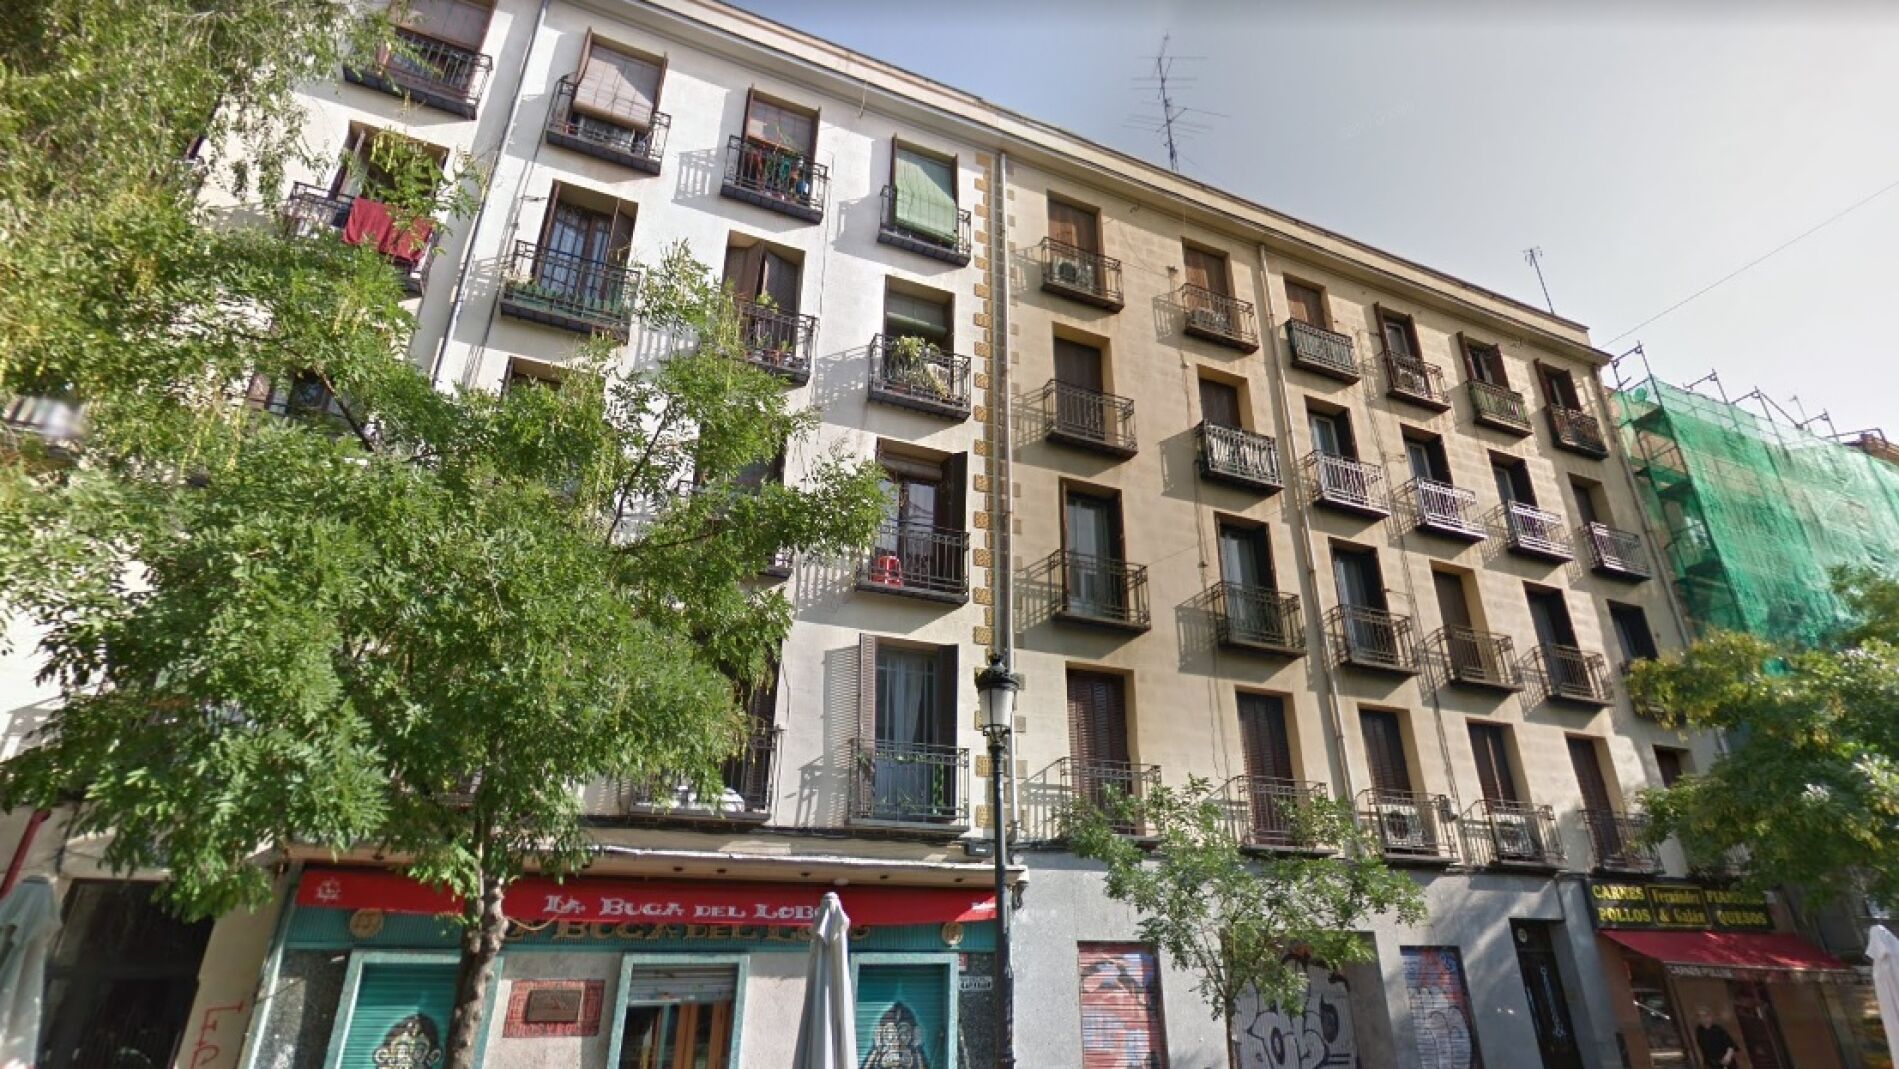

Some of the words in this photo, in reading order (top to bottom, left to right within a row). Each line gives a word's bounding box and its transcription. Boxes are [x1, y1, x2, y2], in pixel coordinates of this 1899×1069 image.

[1592, 885, 1645, 900] CARNES
[542, 895, 586, 914] LA
[693, 905, 746, 918] DEL
[752, 903, 819, 919] LOB
[1598, 907, 1651, 922] POLLOS
